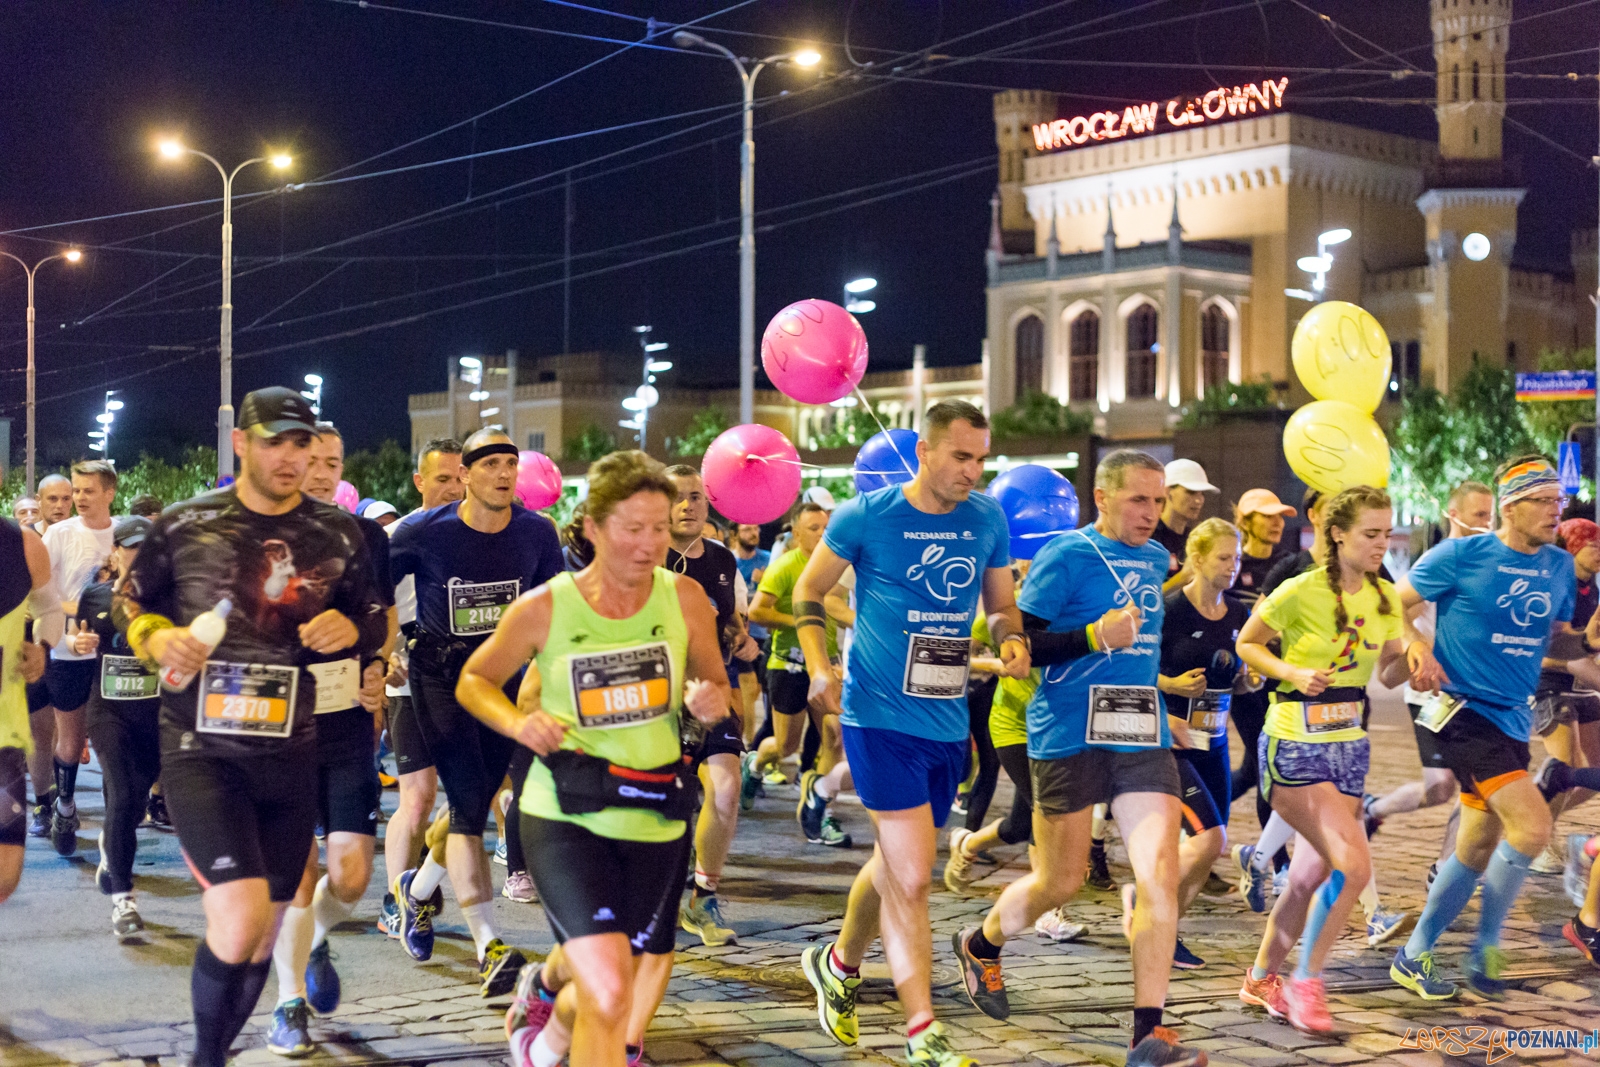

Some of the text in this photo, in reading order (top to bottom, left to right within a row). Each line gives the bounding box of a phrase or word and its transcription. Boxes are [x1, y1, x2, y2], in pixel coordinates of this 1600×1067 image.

[1032, 102, 1158, 150] WROCŁAW
[903, 531, 958, 540] PACEMAKER
[469, 607, 502, 624] 2142
[115, 677, 145, 690] 8712
[602, 684, 649, 712] 1861
[222, 697, 271, 720] 2370
